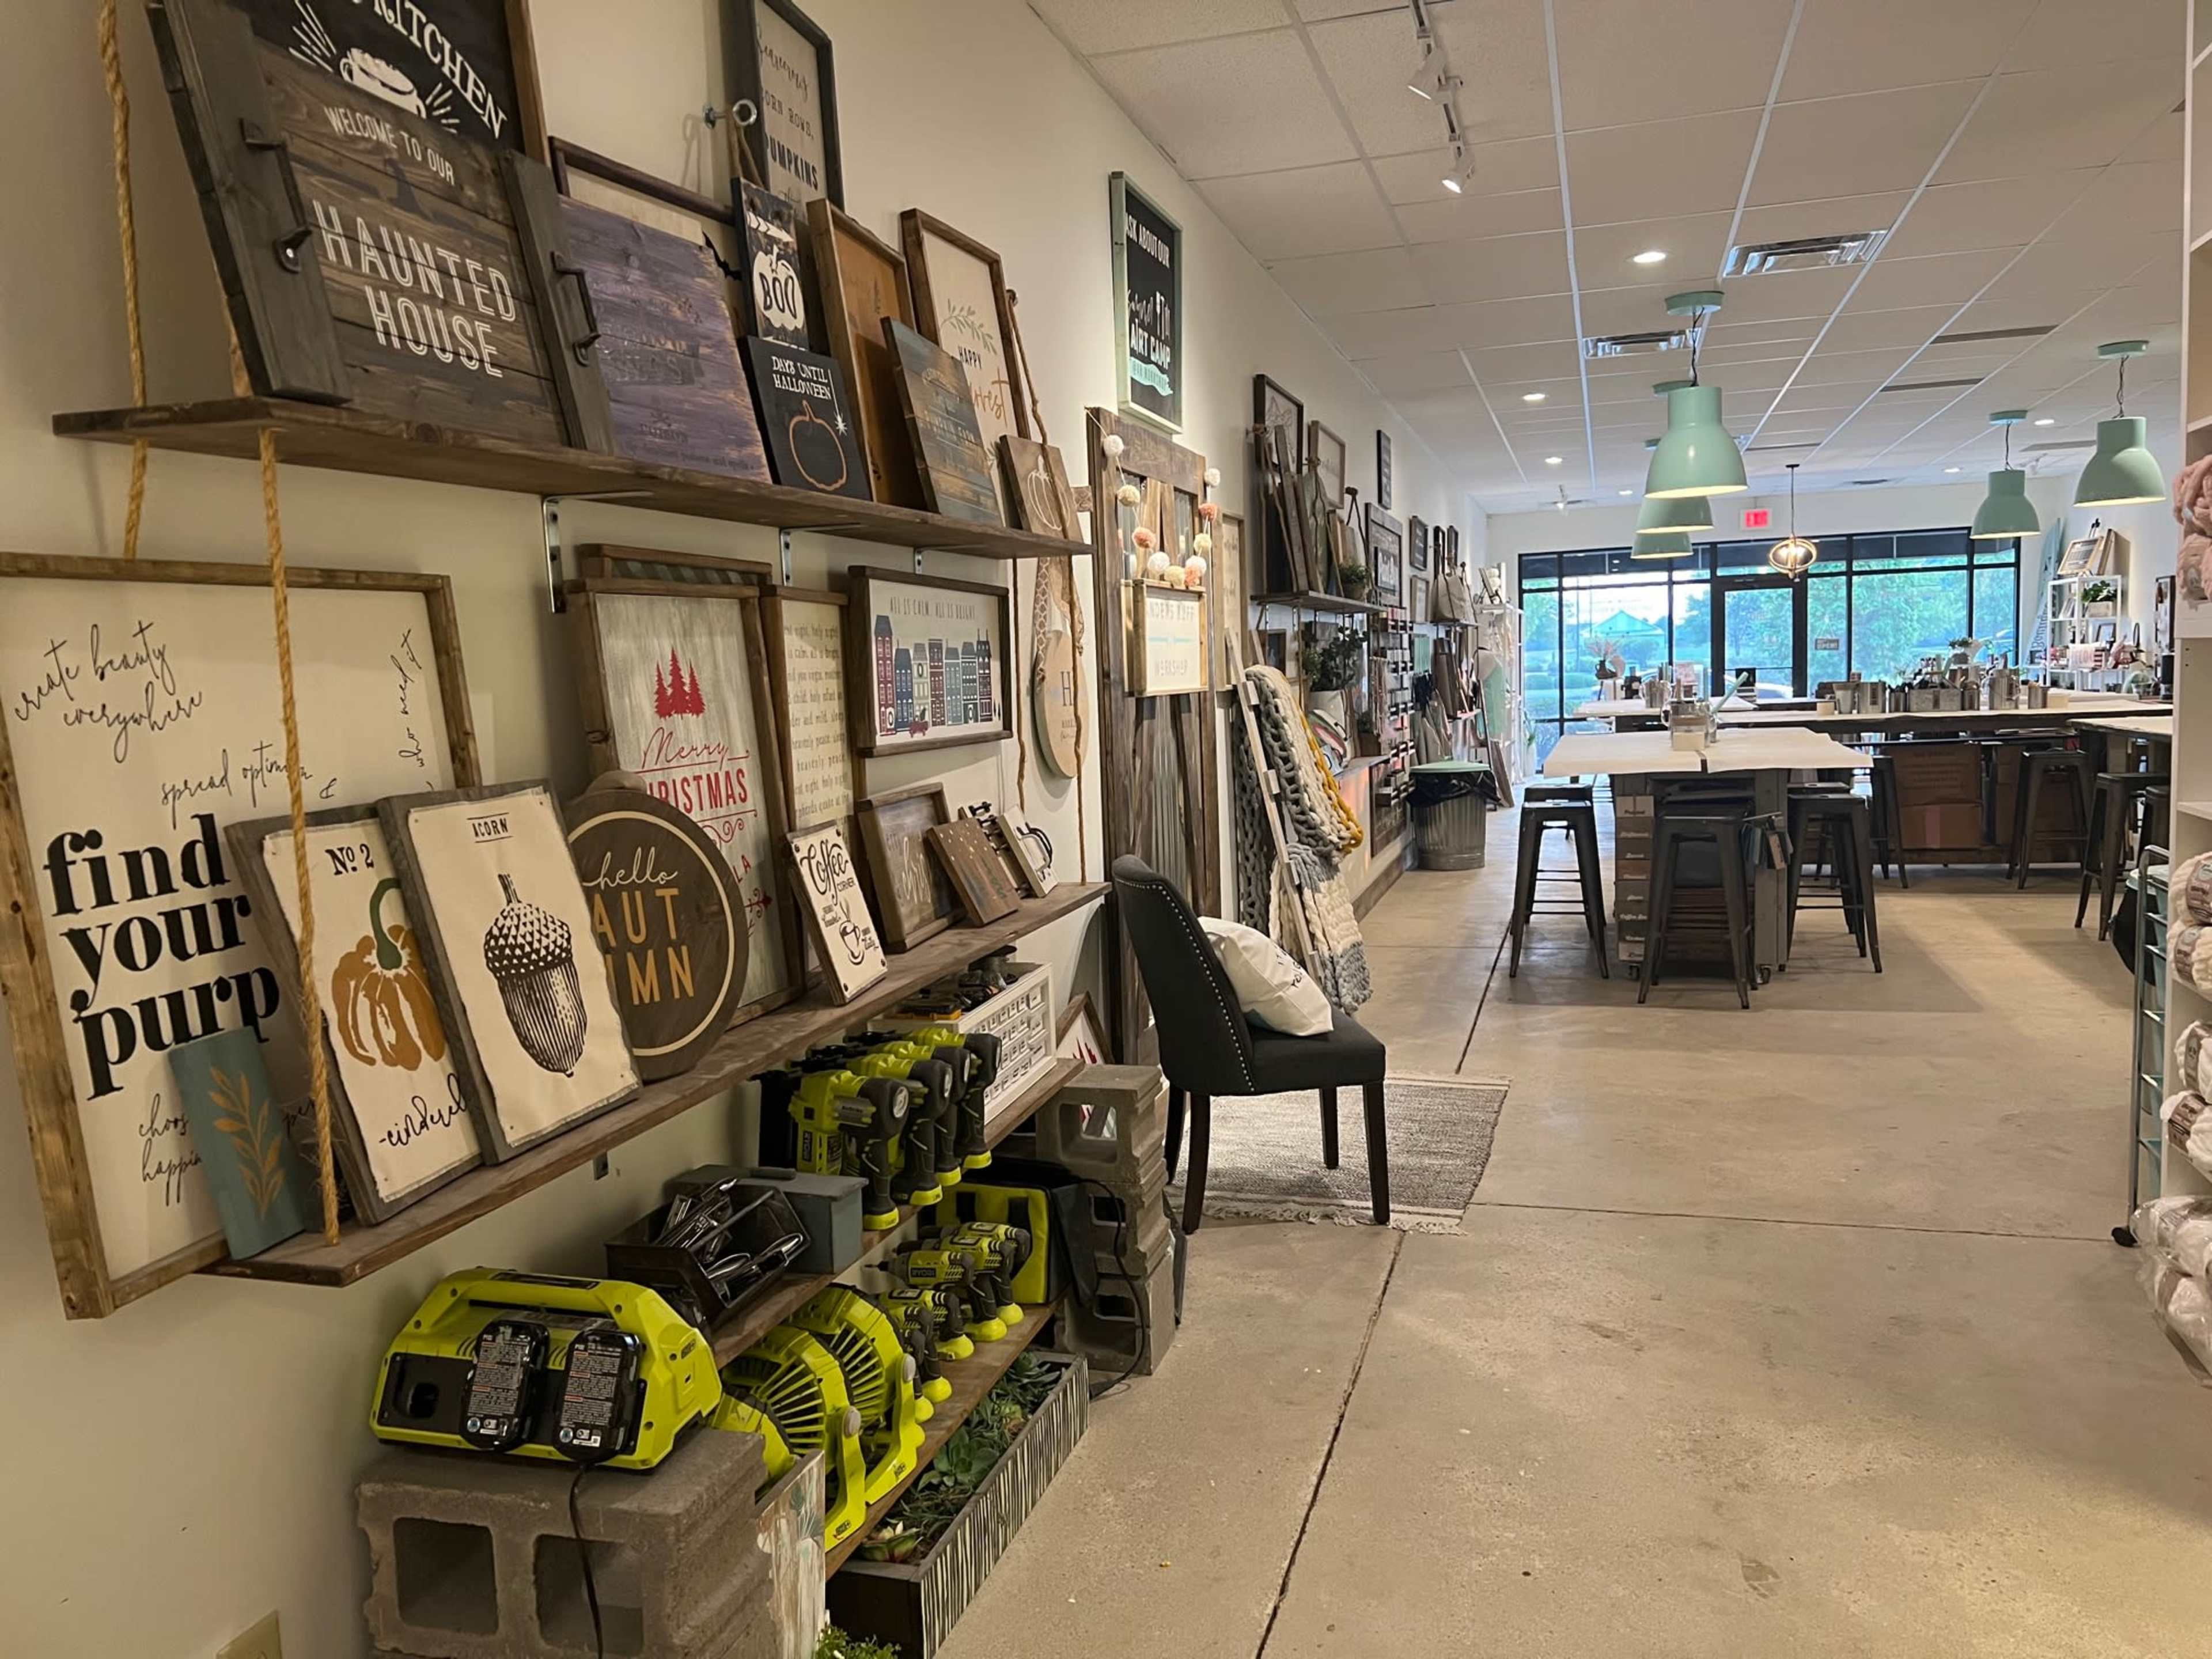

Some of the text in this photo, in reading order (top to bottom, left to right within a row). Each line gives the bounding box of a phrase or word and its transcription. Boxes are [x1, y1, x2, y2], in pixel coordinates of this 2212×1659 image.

[323, 106, 454, 185] WELCOME TO OUR
[313, 200, 516, 322] HAUNTED
[759, 272, 798, 320] BOO
[365, 285, 504, 377] HOUSE
[771, 356, 828, 382] DAYS UNTIL
[773, 373, 831, 400] HALLOWEEN
[14, 620, 176, 721] create beauty
[401, 628, 422, 670] it
[63, 680, 202, 763] everywhere
[642, 726, 729, 771] Merry
[161, 748, 232, 831] spread
[359, 843, 374, 869] 2
[472, 818, 508, 838] ACORN
[43, 813, 232, 916] find
[582, 846, 678, 891] hello
[800, 838, 849, 906] Coffee
[592, 888, 680, 948] AUT
[59, 895, 252, 1013] your
